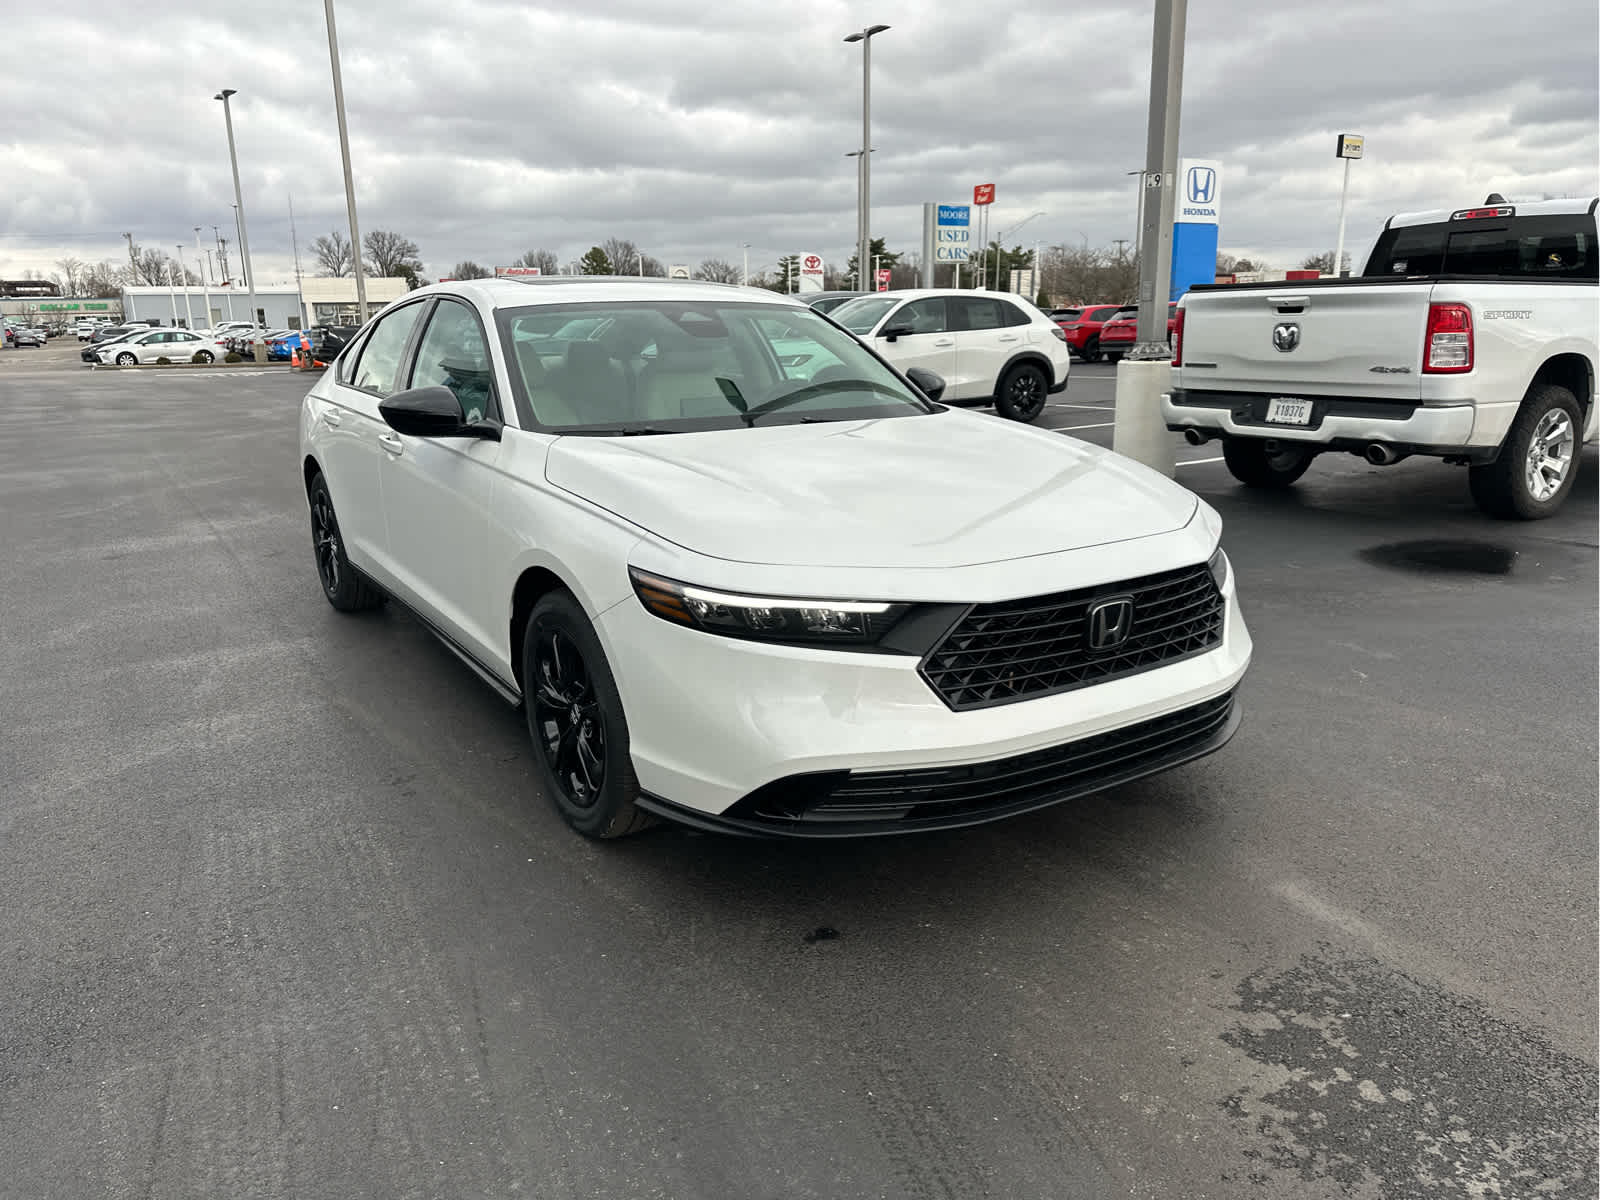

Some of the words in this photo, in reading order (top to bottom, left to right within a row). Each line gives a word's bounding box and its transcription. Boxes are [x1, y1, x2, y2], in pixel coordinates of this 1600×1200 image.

[940, 210, 969, 220] MOORE
[1183, 208, 1216, 216] HONDA
[938, 230, 969, 242] USED
[937, 247, 969, 260] CARS
[1483, 310, 1532, 320] SPORT
